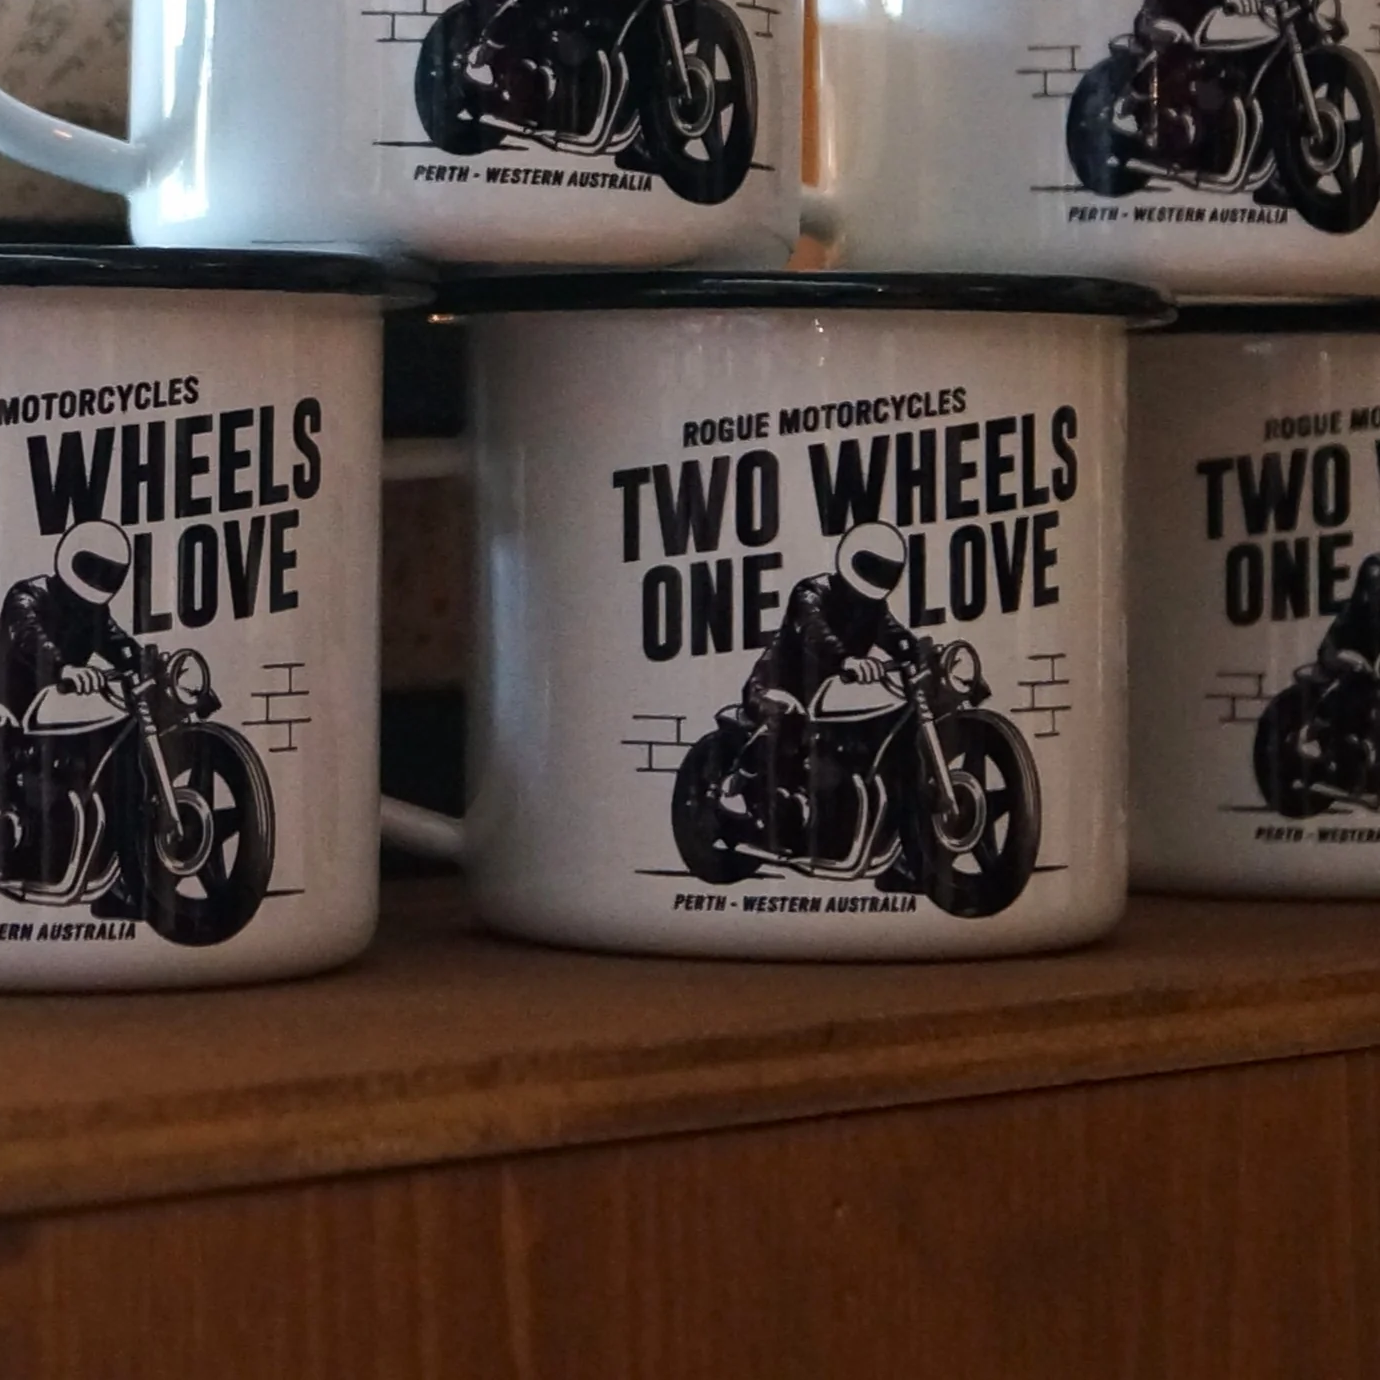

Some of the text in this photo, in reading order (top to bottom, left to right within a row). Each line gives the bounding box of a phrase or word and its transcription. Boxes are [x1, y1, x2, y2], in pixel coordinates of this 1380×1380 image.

[414, 165, 469, 182] PERTH
[485, 167, 565, 186] WESTERN
[567, 170, 652, 191] AUSTRALIA
[1069, 206, 1119, 222] PERTH
[1133, 206, 1206, 223] WESTERN
[1208, 207, 1288, 224] AUSTRALIA
[683, 387, 966, 448] ROGUE MOTORCYCLES
[1264, 410, 1342, 441] ROGUE
[27, 397, 321, 536] WHEELS
[613, 405, 1078, 562] TWO WHEELS
[1196, 442, 1351, 539] TWO
[132, 508, 300, 635] LOVE
[642, 510, 1060, 662] ONE LOVE
[1225, 531, 1354, 627] ONE
[36, 921, 135, 941] AUSTRALIA
[674, 894, 727, 911] PERTH
[743, 895, 822, 913] WESTERN
[824, 895, 917, 913] AUSTRALIA
